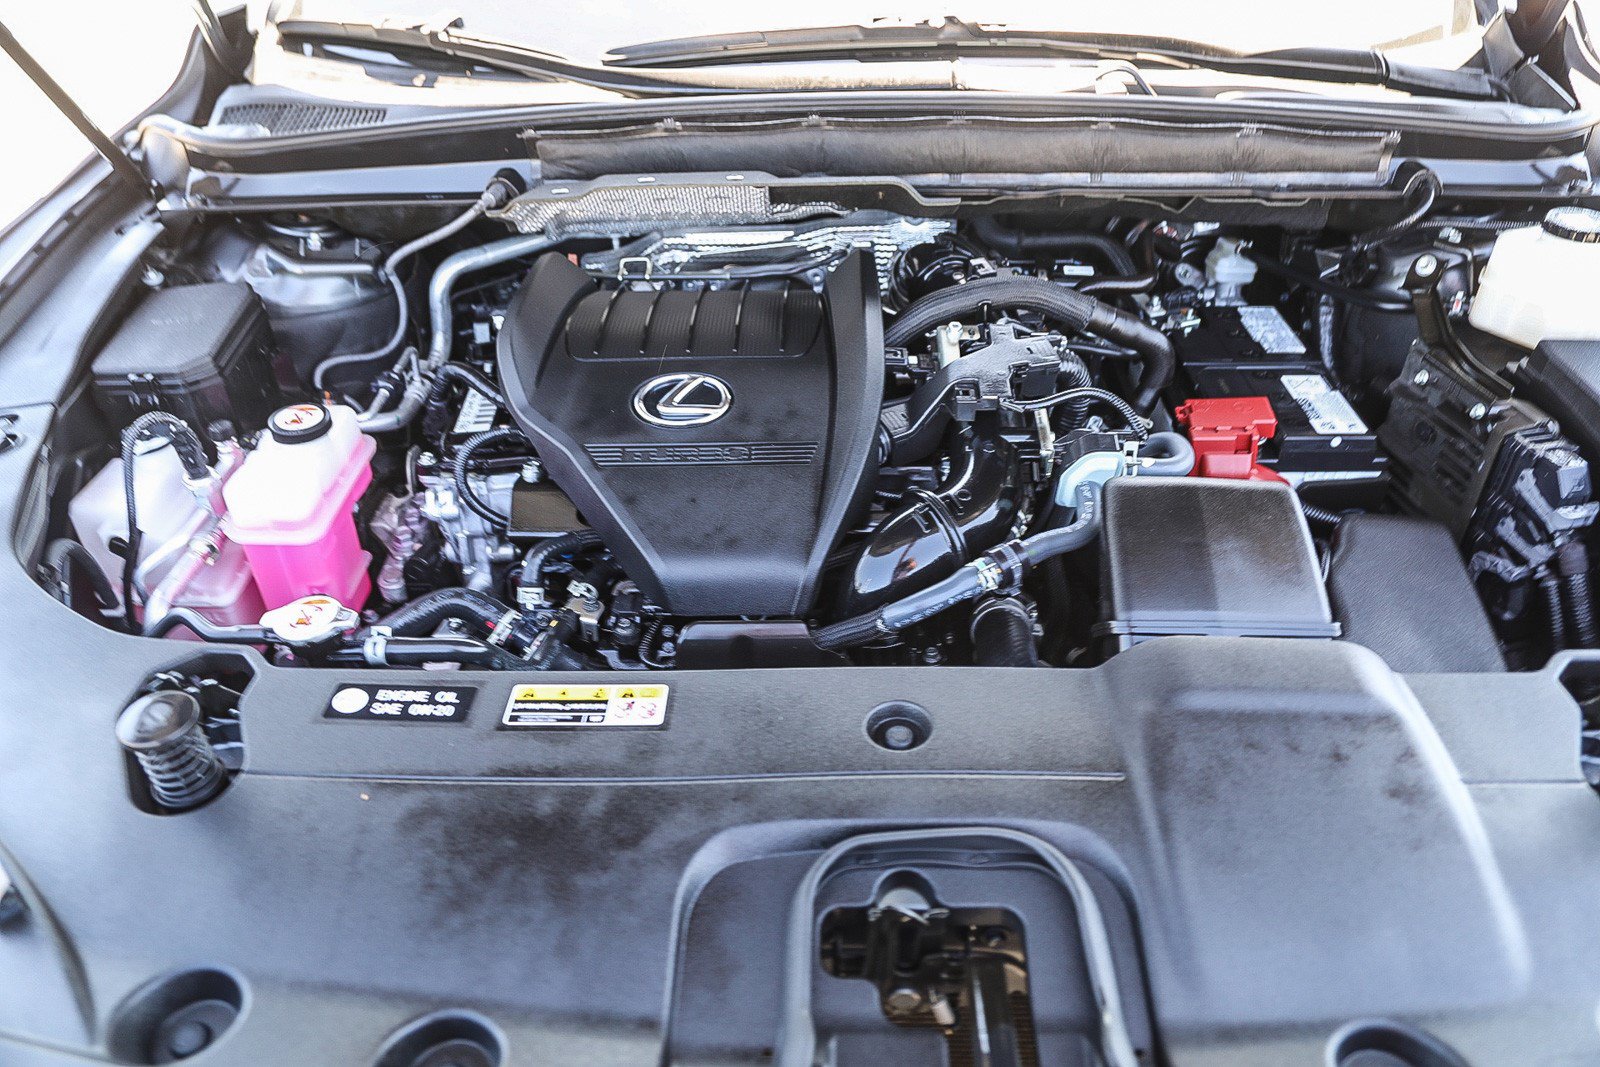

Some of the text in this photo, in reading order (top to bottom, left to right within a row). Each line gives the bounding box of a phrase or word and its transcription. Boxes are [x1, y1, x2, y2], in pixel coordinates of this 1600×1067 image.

[624, 446, 750, 462] TURBO
[375, 689, 461, 704] ENGINE OIL
[369, 702, 405, 715] SAE
